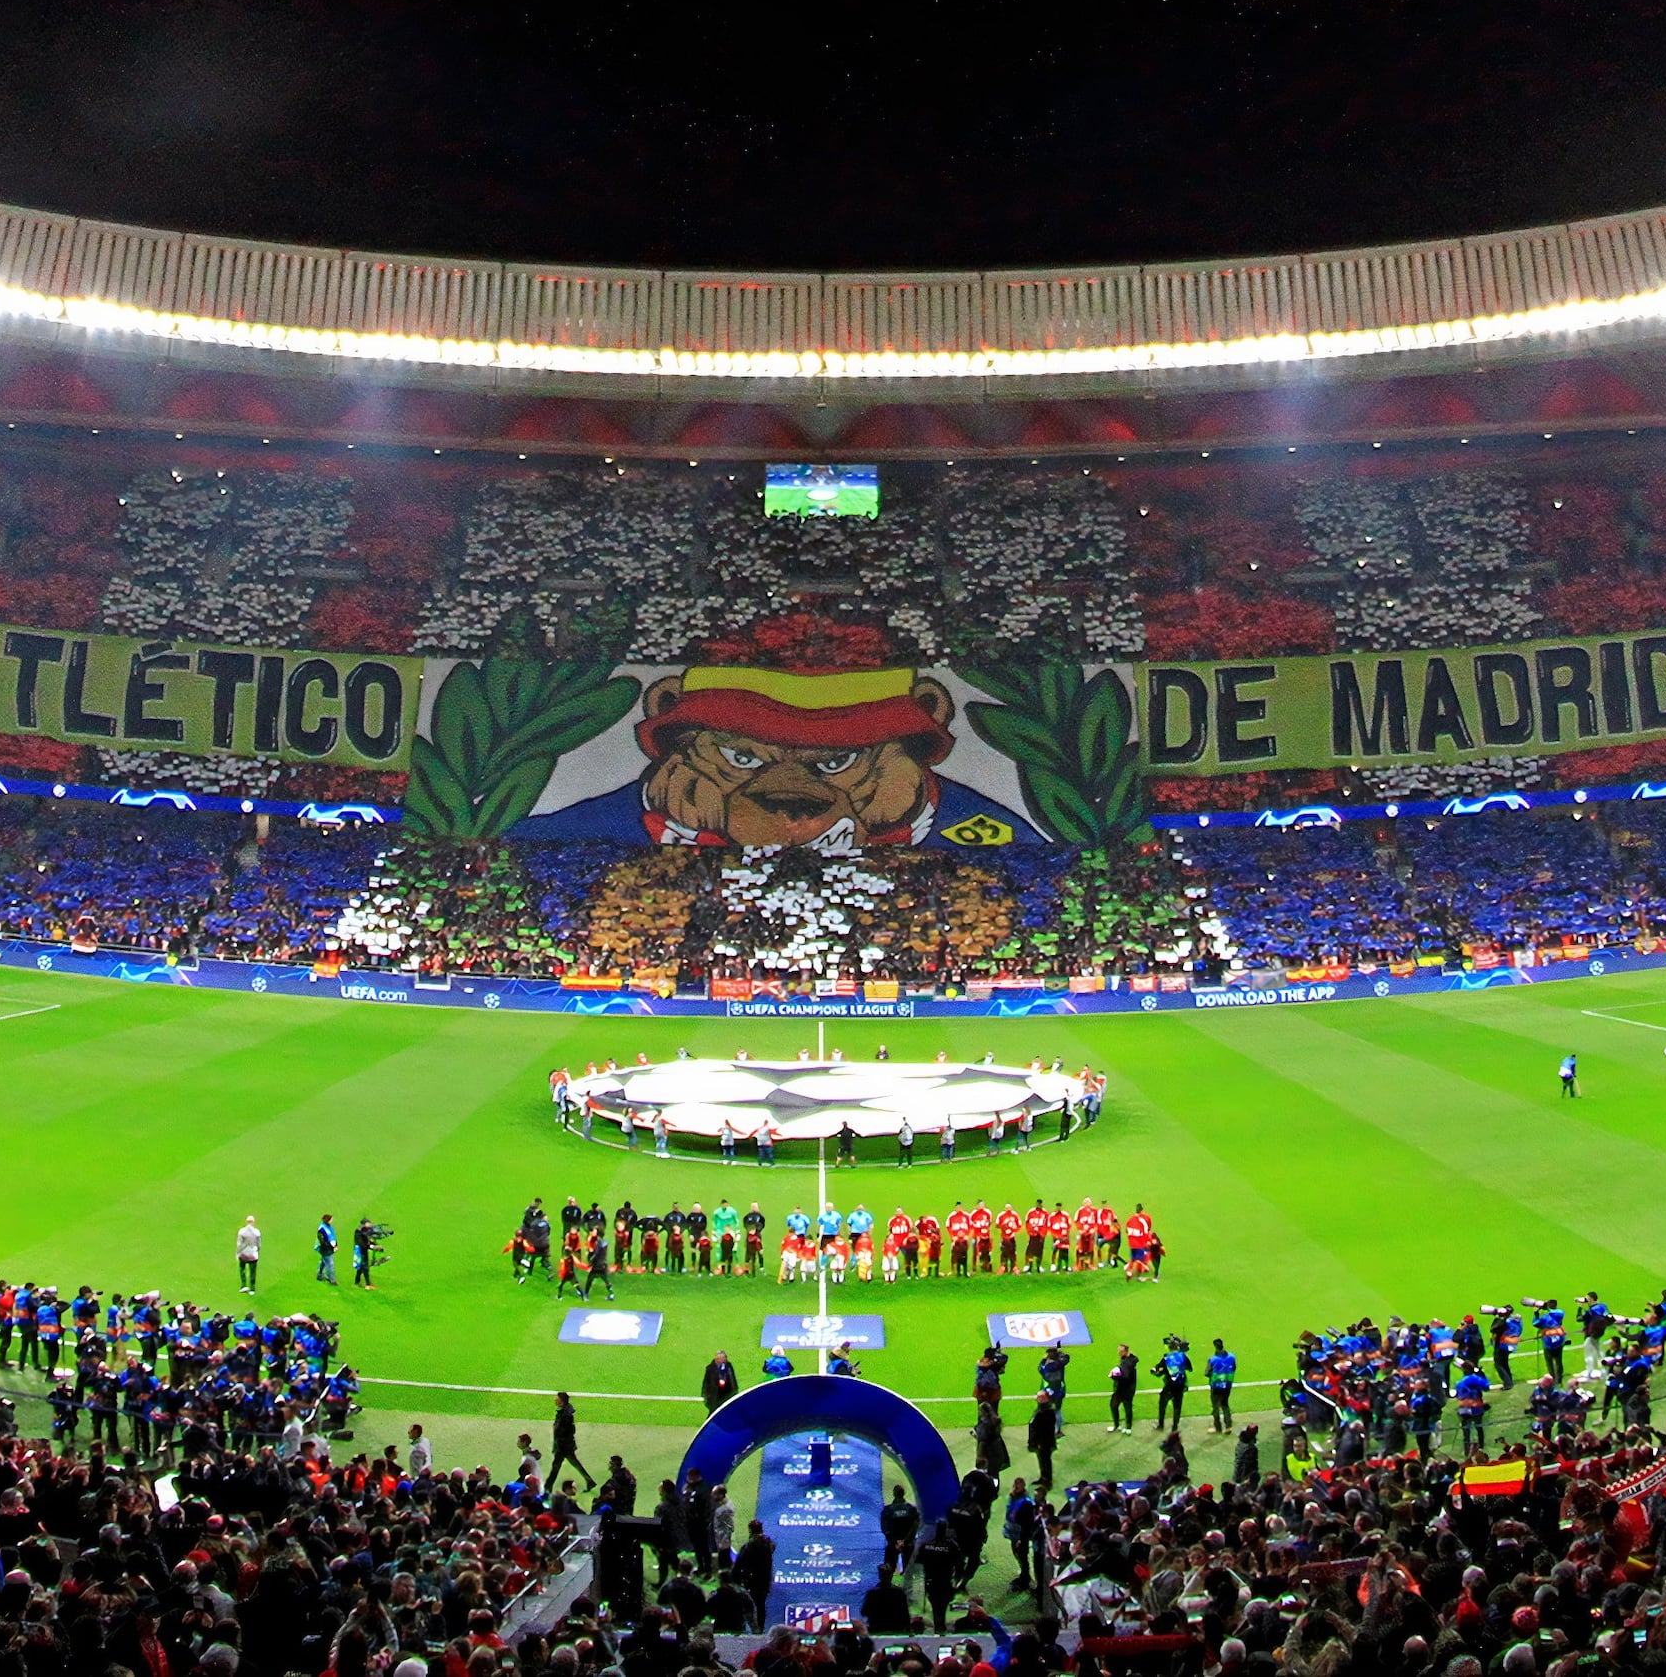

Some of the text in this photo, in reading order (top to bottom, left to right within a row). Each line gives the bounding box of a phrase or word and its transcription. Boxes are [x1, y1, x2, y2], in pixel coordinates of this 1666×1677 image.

[1148, 665, 1277, 765] DE
[1196, 986, 1336, 1007] DOWNLOAD THE APP
[745, 1003, 895, 1015] UEFA CHAMPIONS LEAGUE
